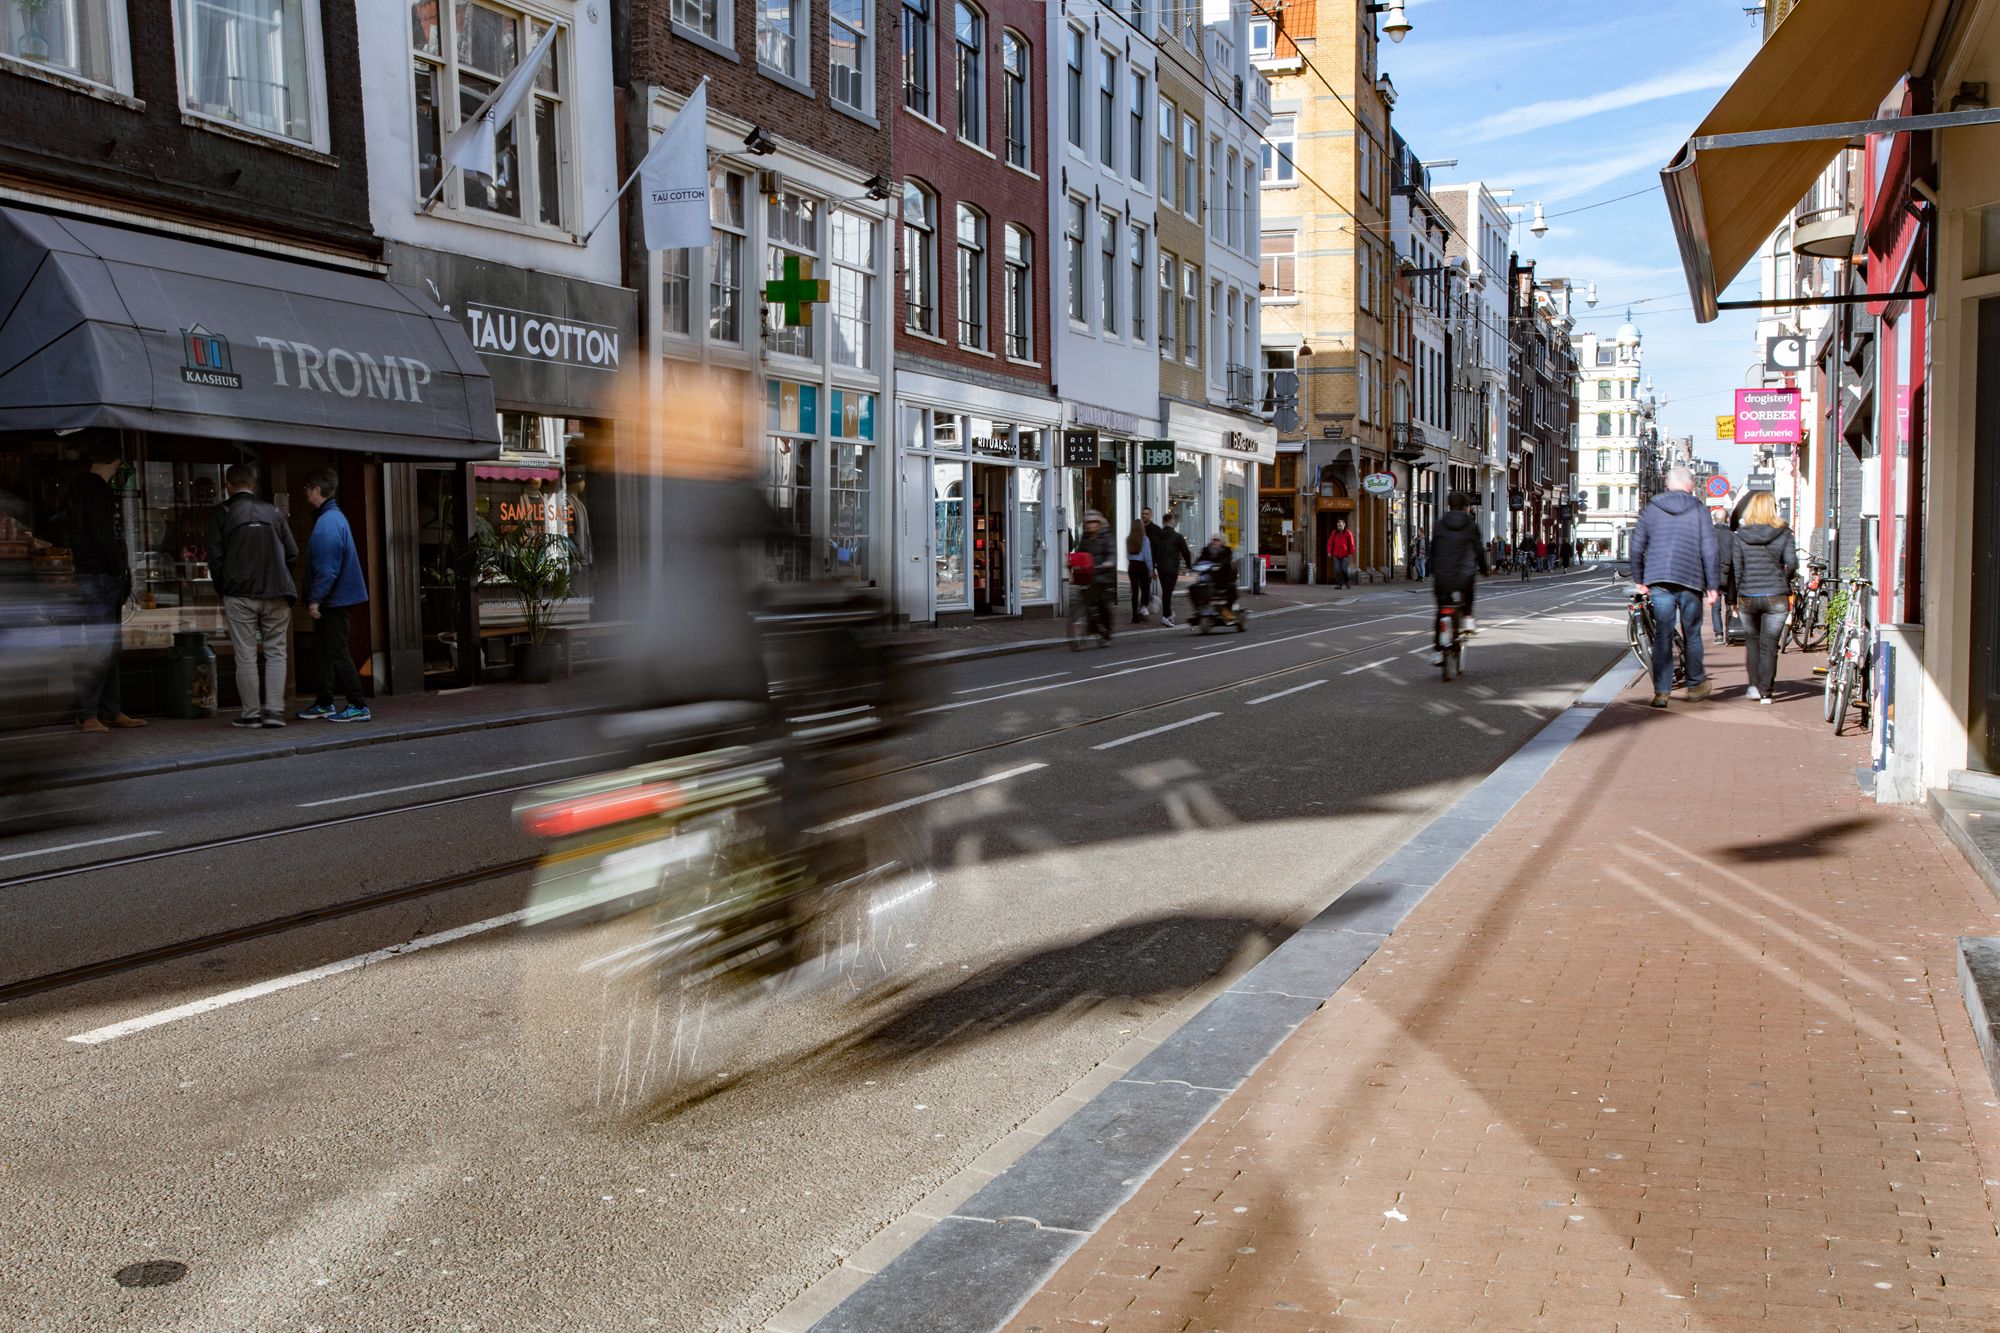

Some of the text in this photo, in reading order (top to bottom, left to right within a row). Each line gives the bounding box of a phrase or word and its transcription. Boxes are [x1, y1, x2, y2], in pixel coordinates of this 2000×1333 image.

[652, 190, 705, 202] TAU COTTON
[467, 308, 619, 367] TAU COTTON
[255, 335, 432, 404] TROMP
[185, 371, 240, 388] KAASHUIS
[1744, 393, 1793, 405] drogisterij
[1739, 410, 1797, 420] OORBEEK
[1744, 428, 1793, 440] parfumerie
[1144, 448, 1173, 466] H&B
[500, 502, 574, 521] SAMPLE SALE
